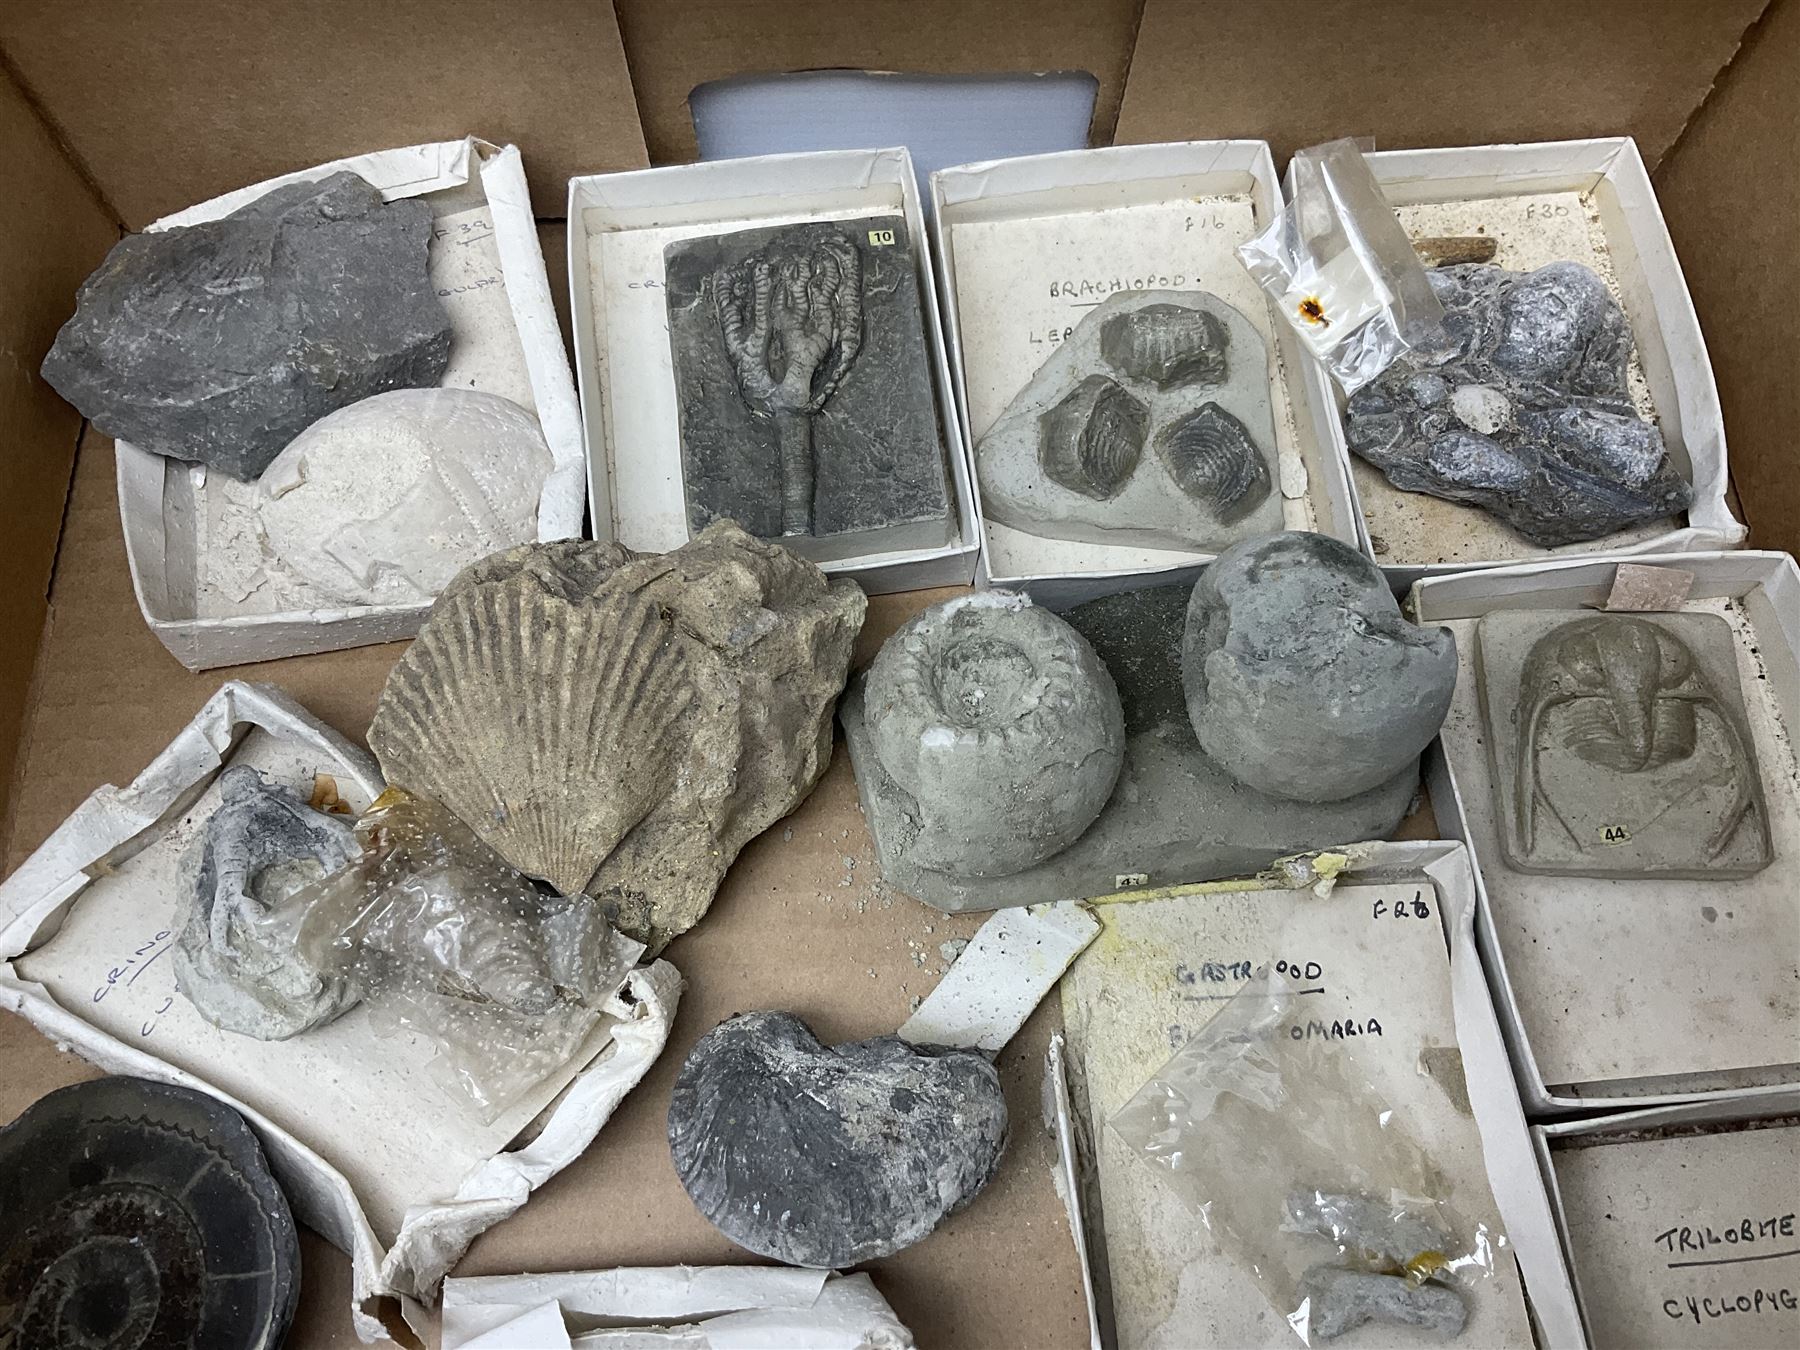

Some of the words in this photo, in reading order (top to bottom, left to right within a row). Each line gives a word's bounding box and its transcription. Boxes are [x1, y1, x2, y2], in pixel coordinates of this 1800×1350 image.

[874, 231, 892, 242] 10
[1605, 826, 1626, 842] 44
[1654, 1212, 1796, 1253] TRILOBITE
